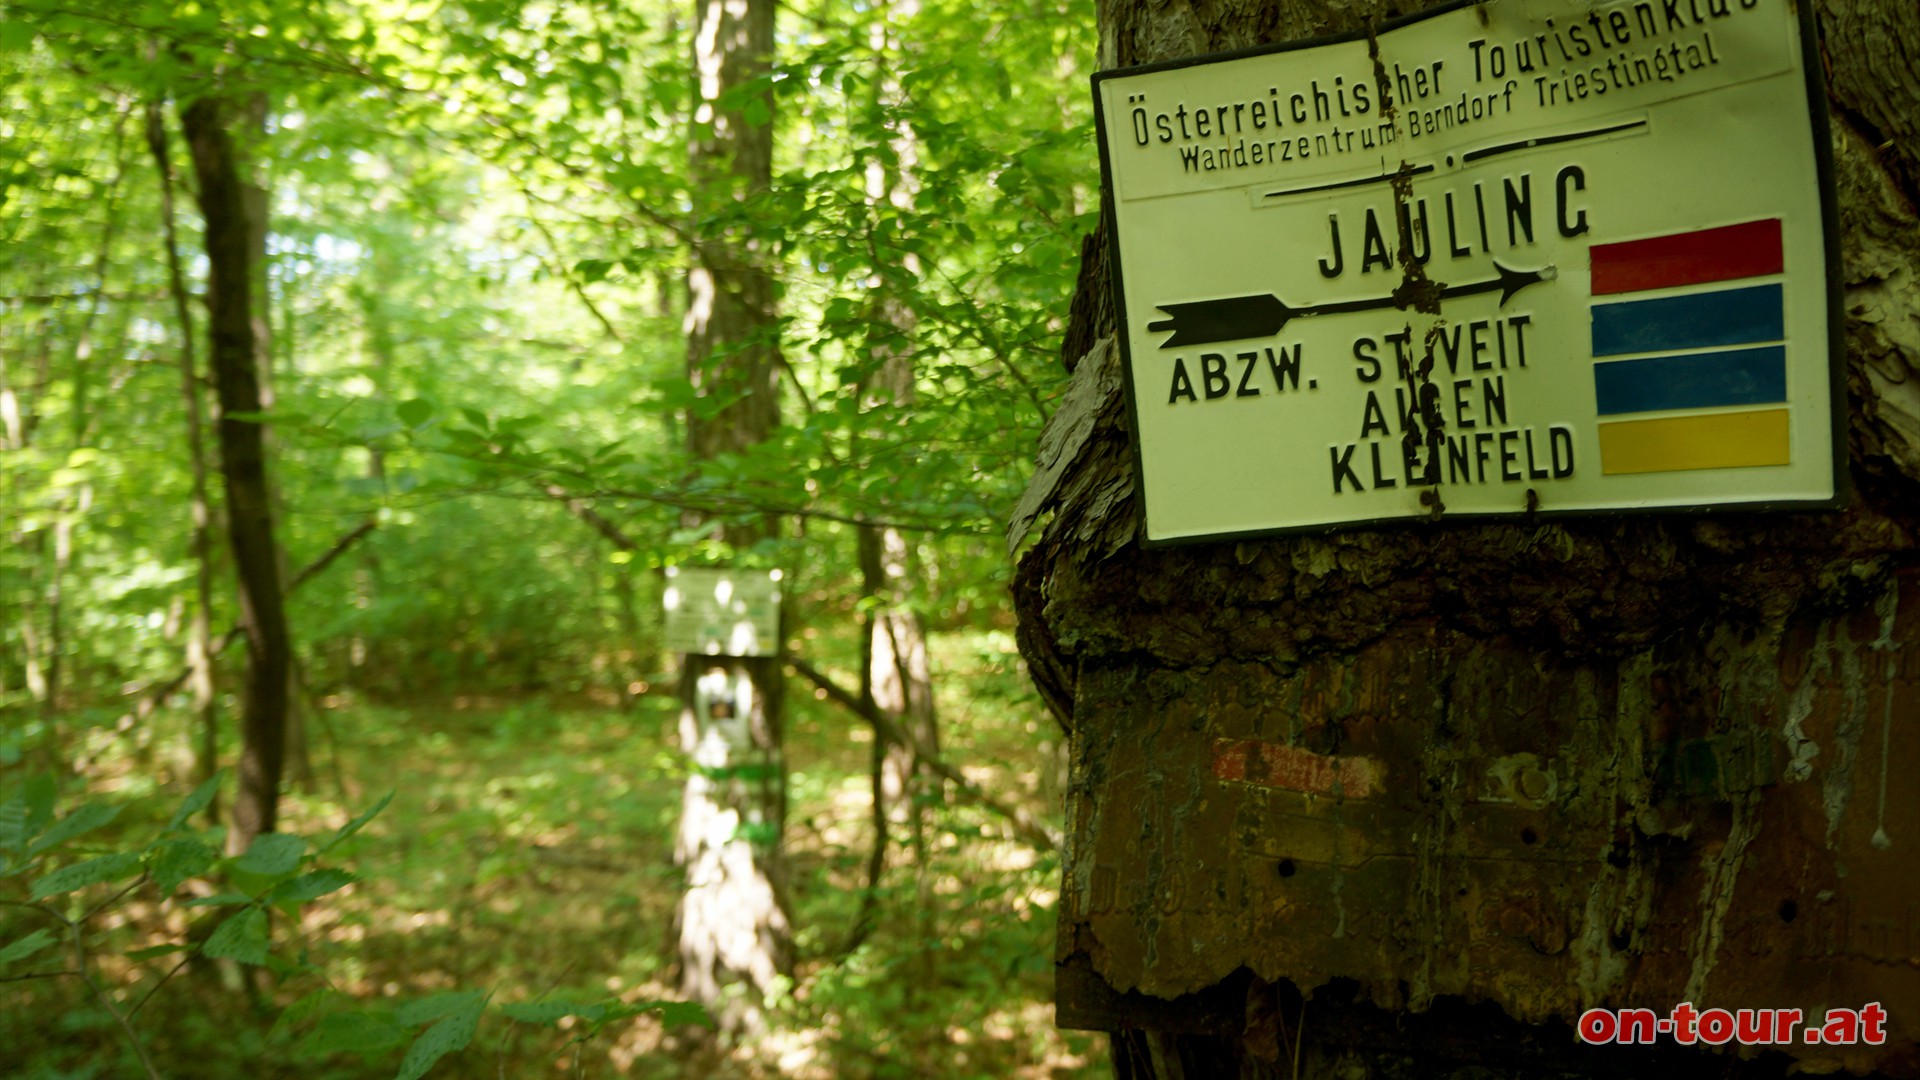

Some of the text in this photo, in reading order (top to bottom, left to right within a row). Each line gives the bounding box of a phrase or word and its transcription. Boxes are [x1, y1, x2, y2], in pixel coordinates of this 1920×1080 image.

[1129, 0, 1757, 146] Österreichischer Touristenklu
[1180, 32, 1719, 172] Wanderzentrum Berndorf Triestingtal
[1318, 165, 1590, 279] JAULING
[1168, 343, 1317, 404] ABZW.
[1439, 315, 1530, 374] VEIT
[1331, 427, 1574, 493] KLEINFELD
